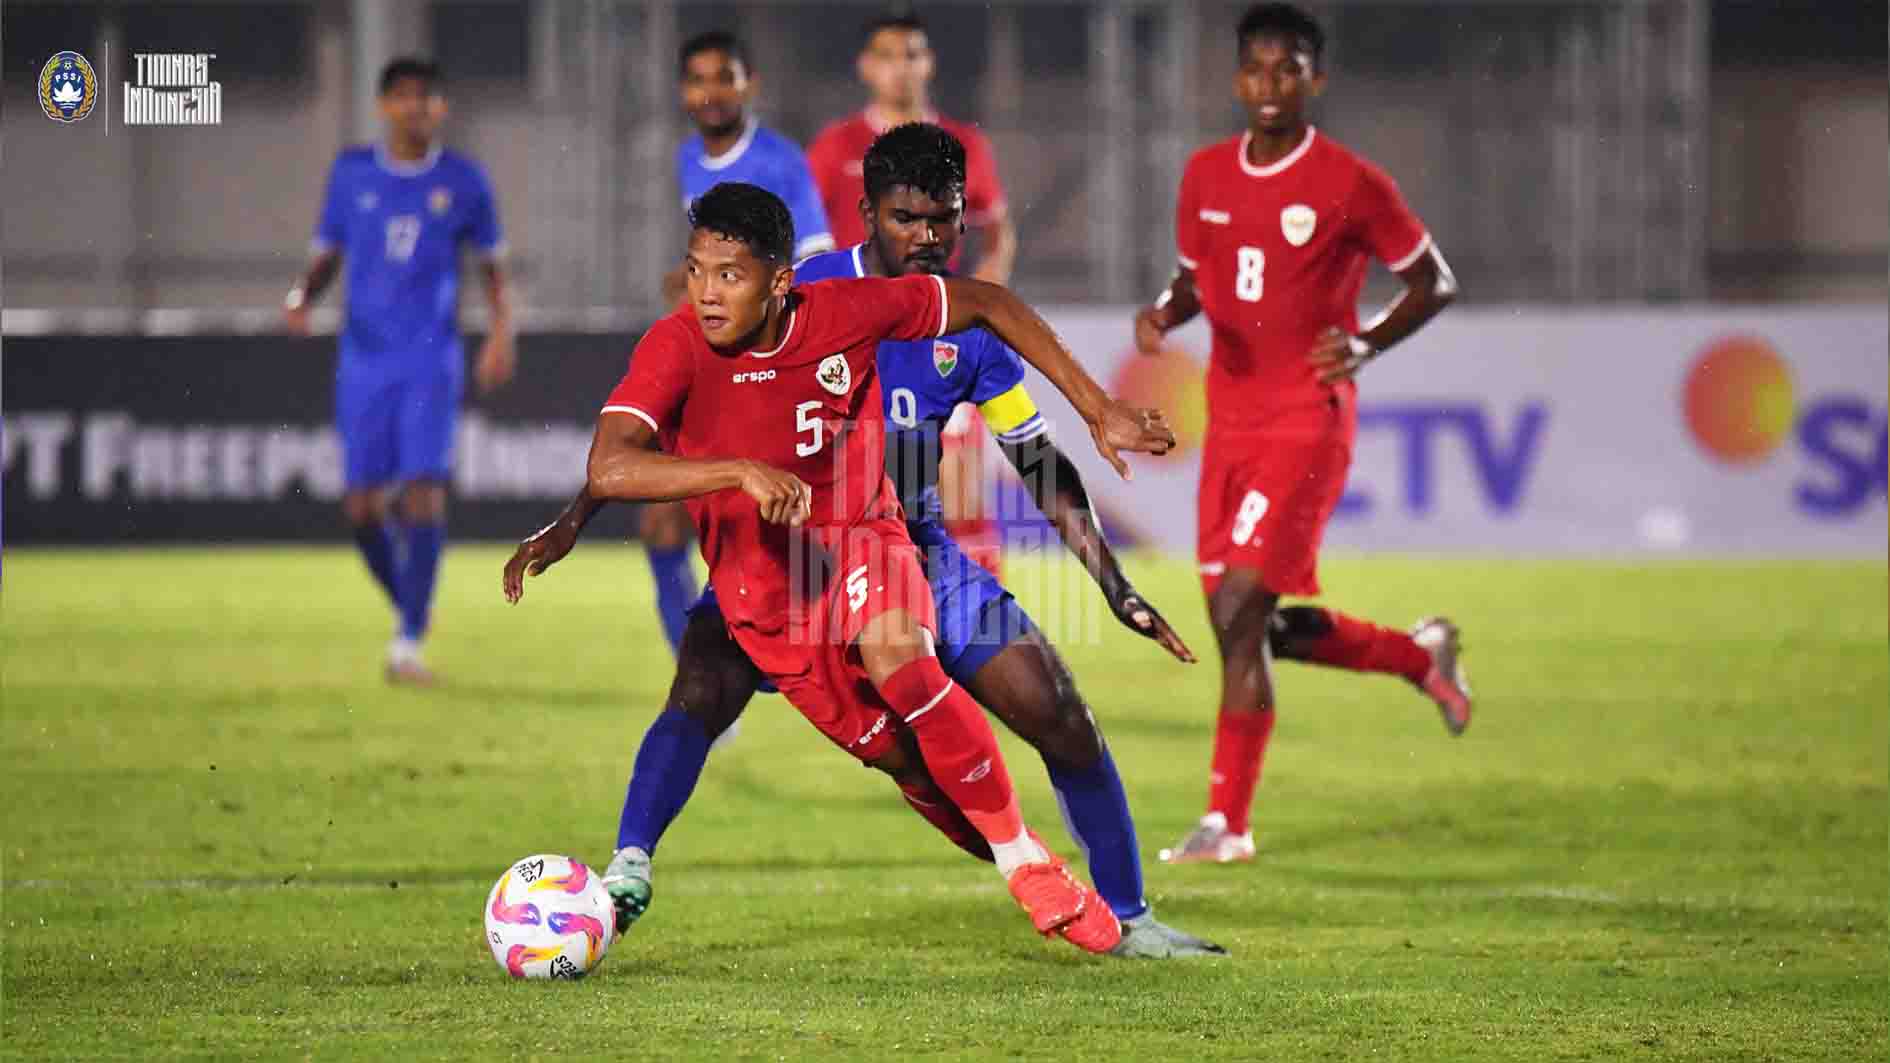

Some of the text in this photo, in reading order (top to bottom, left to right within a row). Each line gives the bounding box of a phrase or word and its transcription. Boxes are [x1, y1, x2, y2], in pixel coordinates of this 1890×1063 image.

[1236, 246, 1265, 301] 8
[733, 369, 776, 384] erspo
[795, 400, 824, 457] 5
[1795, 392, 1888, 517] S
[1232, 489, 1270, 545] 8
[846, 564, 869, 613] 5
